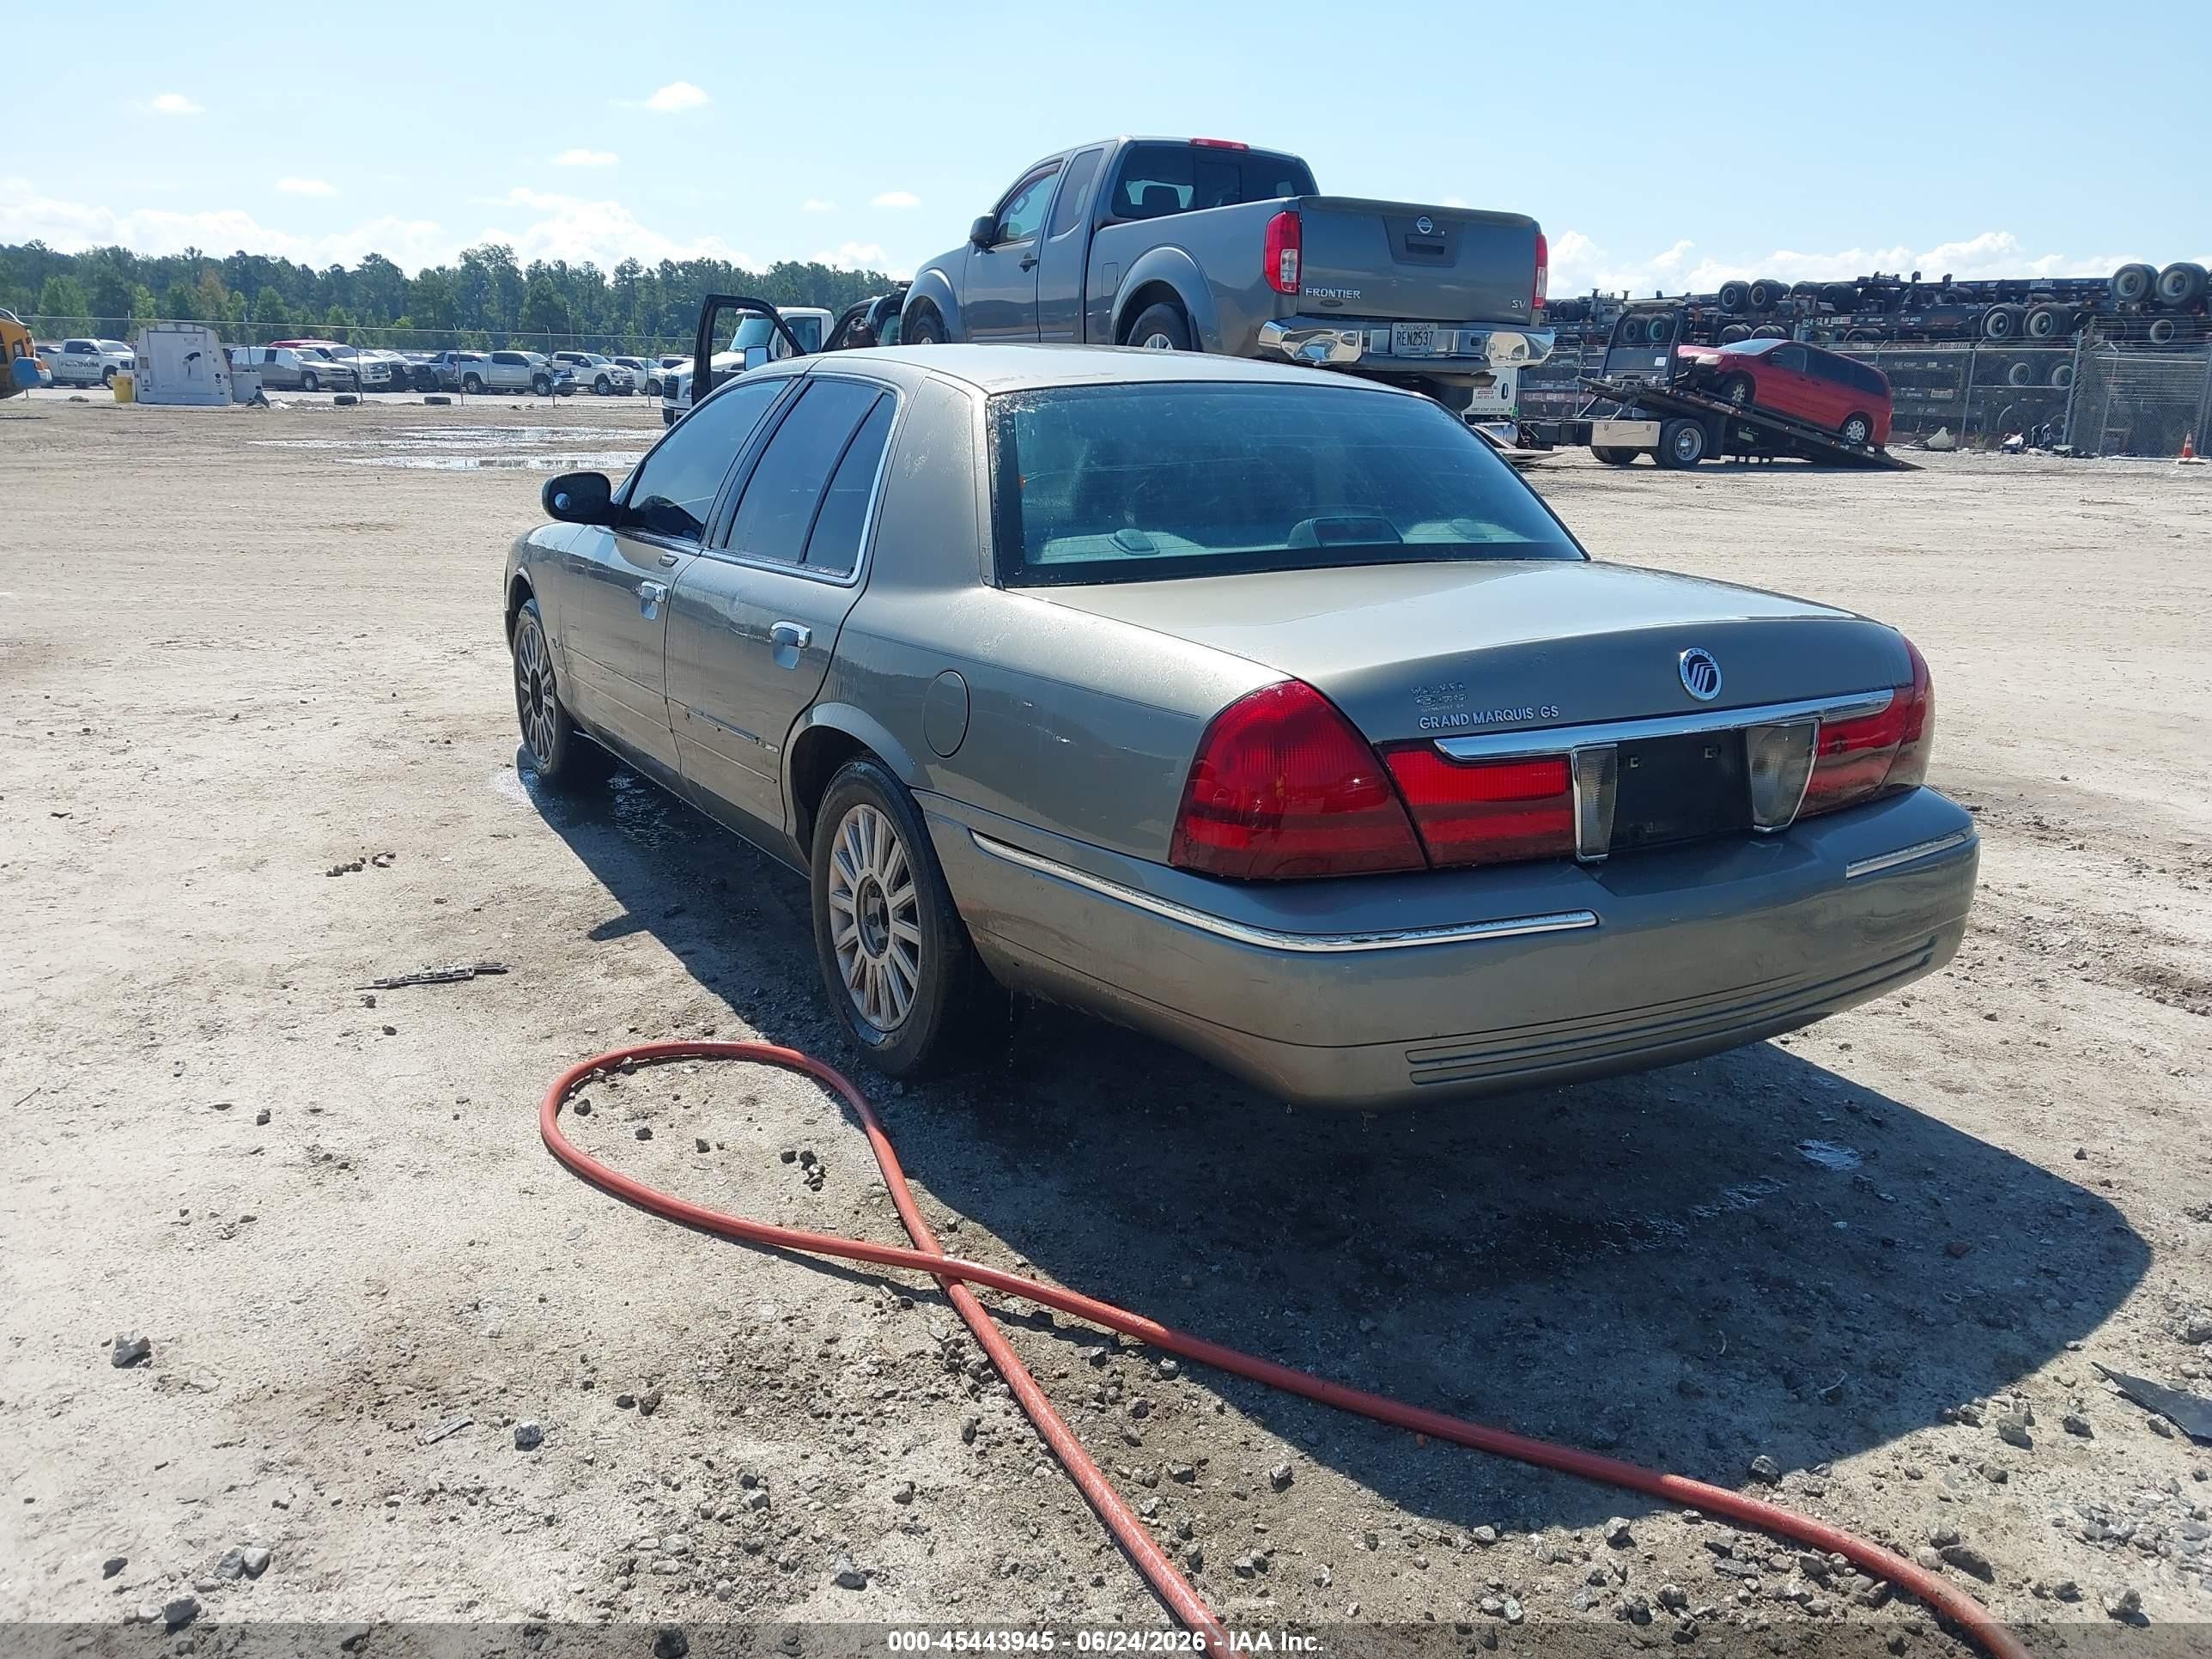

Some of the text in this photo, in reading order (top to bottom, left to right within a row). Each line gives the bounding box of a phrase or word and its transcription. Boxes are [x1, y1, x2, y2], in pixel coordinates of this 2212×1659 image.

[1305, 288, 1361, 299] FRONTIER
[1511, 300, 1526, 308] SV
[1396, 331, 1434, 346] REN2537
[1419, 713, 1469, 729] GRAND
[1474, 707, 1534, 724] MARQUIS
[1540, 705, 1559, 718] GS
